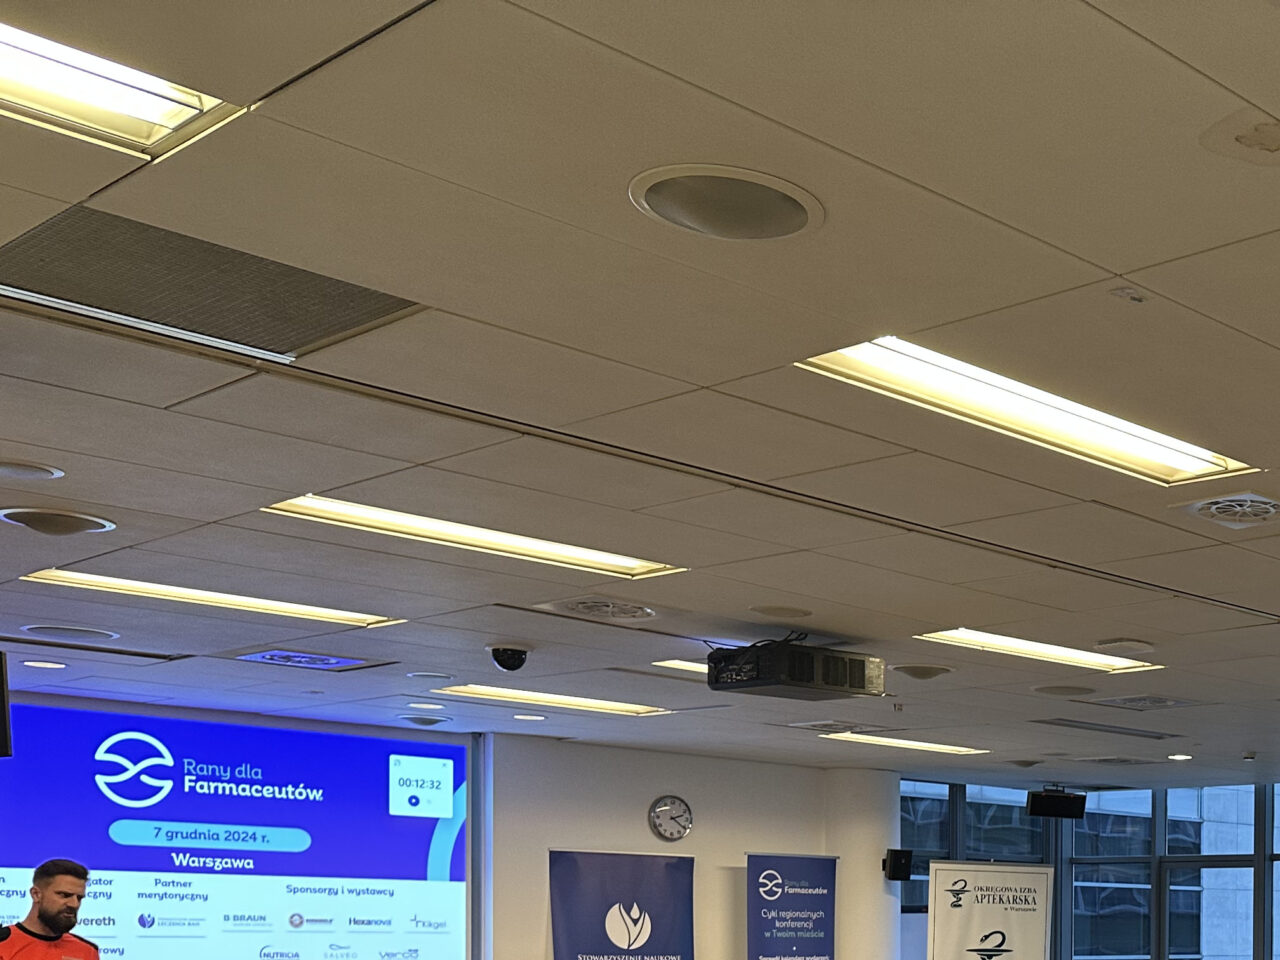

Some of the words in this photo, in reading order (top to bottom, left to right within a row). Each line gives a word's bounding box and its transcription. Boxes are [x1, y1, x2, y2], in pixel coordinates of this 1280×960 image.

[183, 758, 231, 780] Rany
[235, 763, 262, 779] dla
[398, 777, 442, 790] 00:12:32
[154, 826, 162, 838] 7
[165, 828, 220, 842] grudnia
[224, 830, 257, 843] 2024
[261, 835, 270, 843] r.
[171, 852, 254, 871] Warszawa
[154, 878, 192, 888] Partner
[286, 884, 339, 896] Sponsorzy
[347, 887, 395, 897] wystawcy
[784, 886, 828, 894] Farmaceutów
[137, 891, 209, 902] merytoryczny
[974, 894, 1037, 905] APTEKARSKA
[761, 908, 778, 919] Cykl
[779, 909, 825, 919] regionalnych
[775, 919, 814, 929] konferencji
[772, 929, 796, 938] Twoim
[797, 929, 825, 938] mieście
